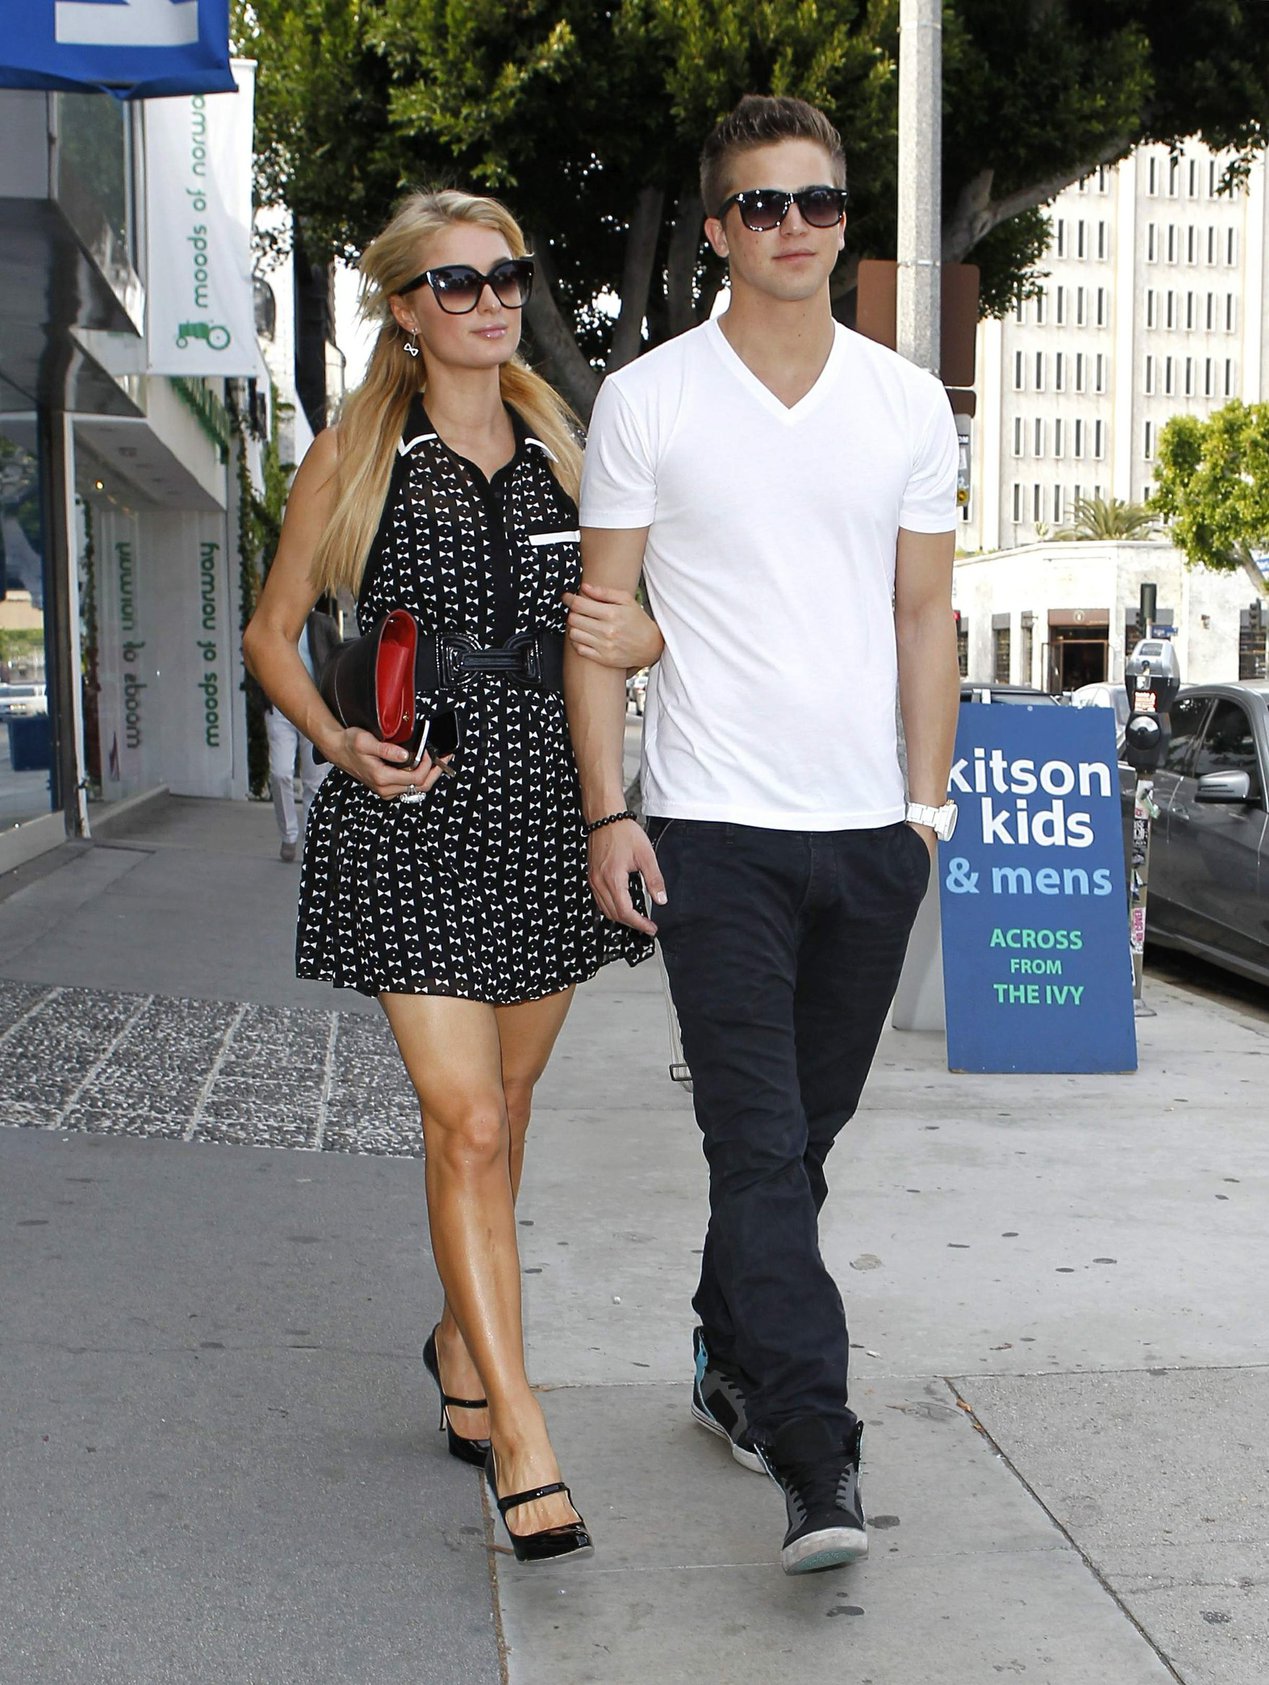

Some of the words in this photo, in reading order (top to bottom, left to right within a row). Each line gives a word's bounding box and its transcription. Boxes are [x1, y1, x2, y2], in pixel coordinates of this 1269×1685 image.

[192, 94, 206, 176] norwa
[186, 188, 206, 211] of
[188, 226, 208, 308] moods
[200, 542, 219, 630] norway
[197, 641, 216, 661] of
[198, 672, 219, 747] moods
[947, 747, 1112, 796] kitson
[981, 797, 1094, 848] kids
[946, 857, 980, 894] &
[992, 867, 1113, 896] mens
[990, 928, 1083, 949] ACROSS
[1010, 959, 1062, 974] FROM
[993, 984, 1040, 1004] THE
[1046, 985, 1084, 1005] IVY
